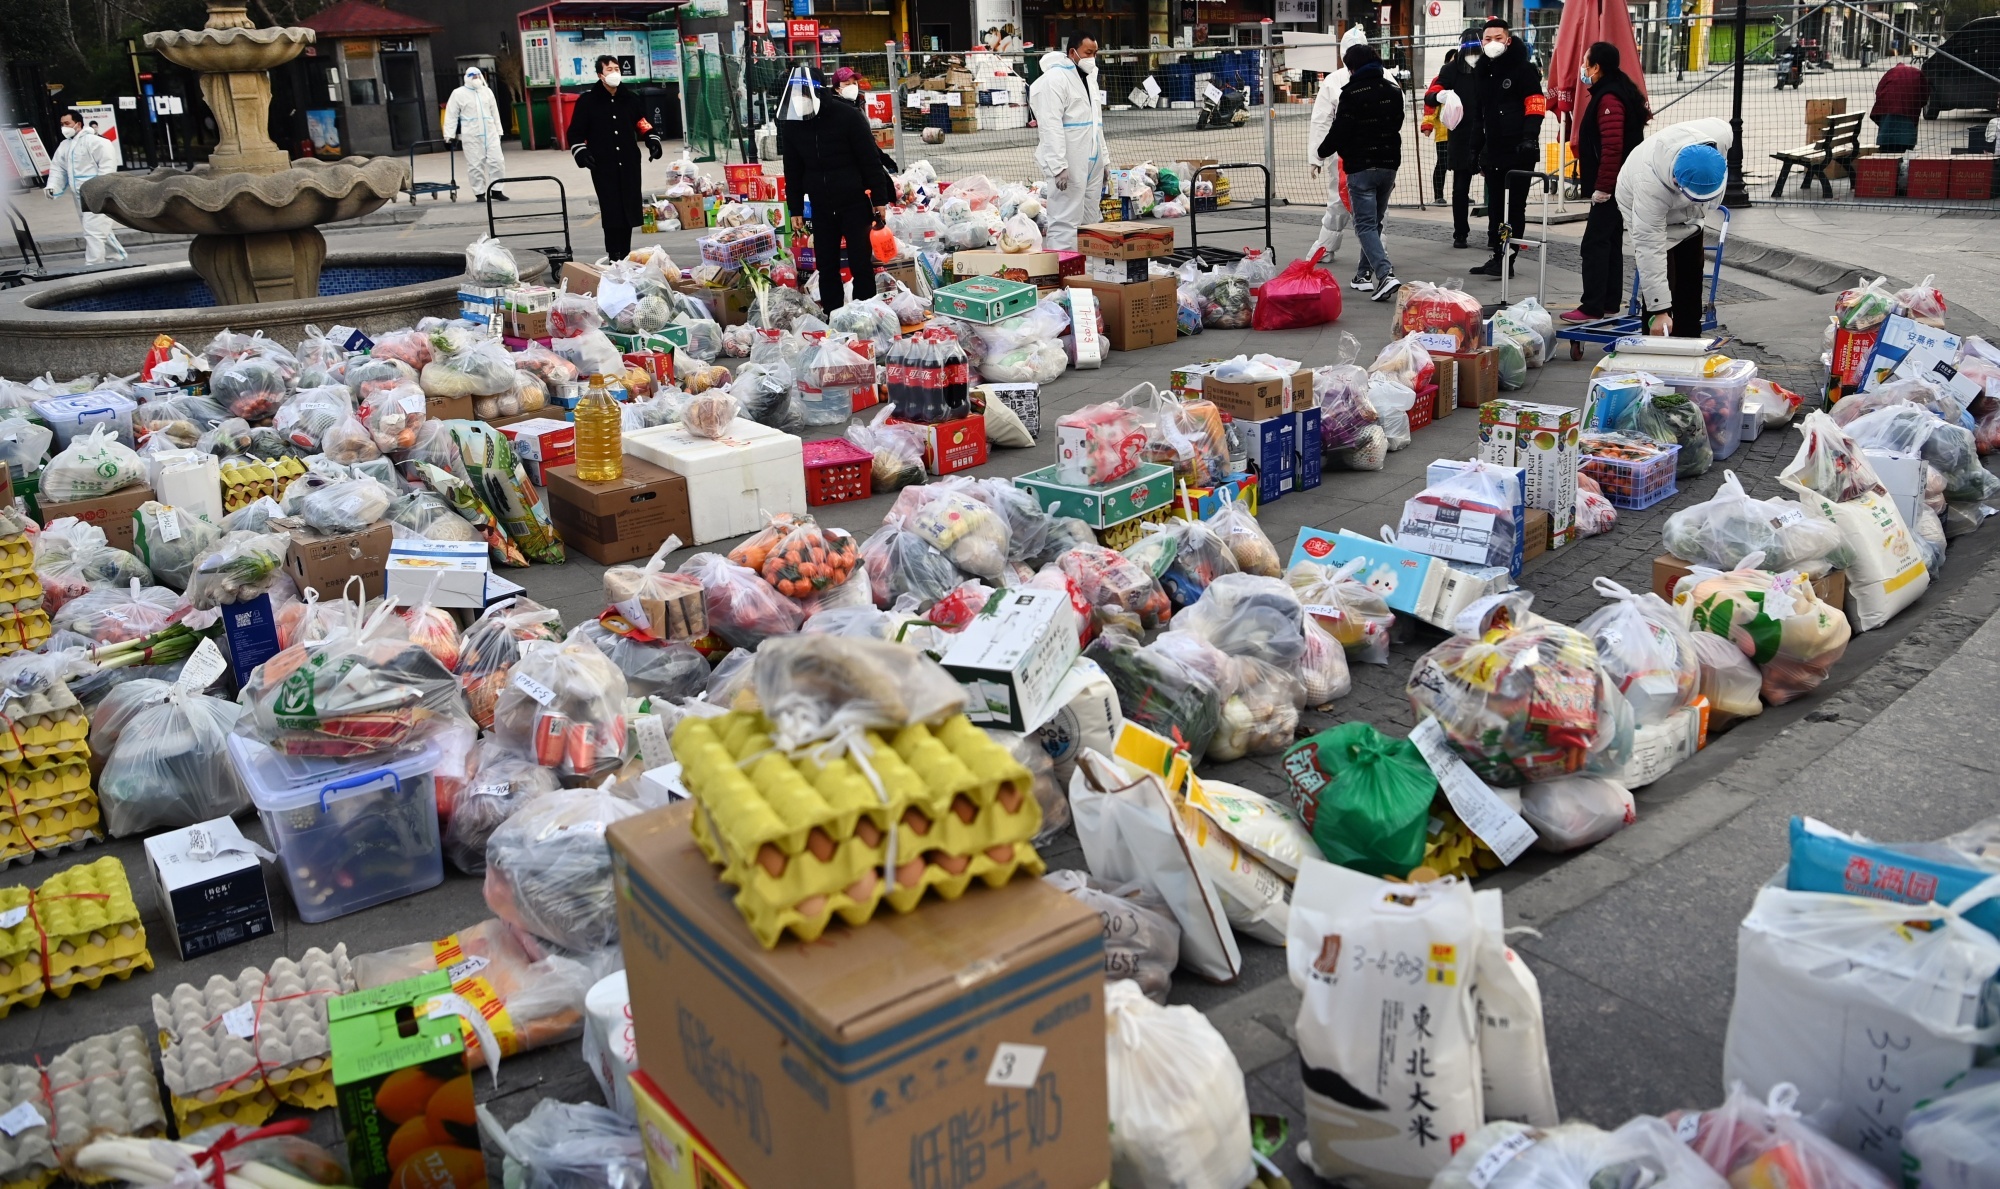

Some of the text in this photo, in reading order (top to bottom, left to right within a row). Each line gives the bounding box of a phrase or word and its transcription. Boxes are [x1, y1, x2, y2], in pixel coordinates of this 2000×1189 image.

[1908, 332, 1935, 348] 安慕希
[1524, 452, 1537, 510] Korla pear
[1428, 541, 1453, 555] 纯牛奶
[1844, 855, 1939, 902] 香满园
[1352, 944, 1425, 985] 3-4-803
[995, 1052, 1017, 1080] 3
[1405, 1002, 1441, 1148] 東北大米
[364, 1117, 387, 1177] ORANGE
[909, 1071, 1063, 1189] 低脂牛奶
